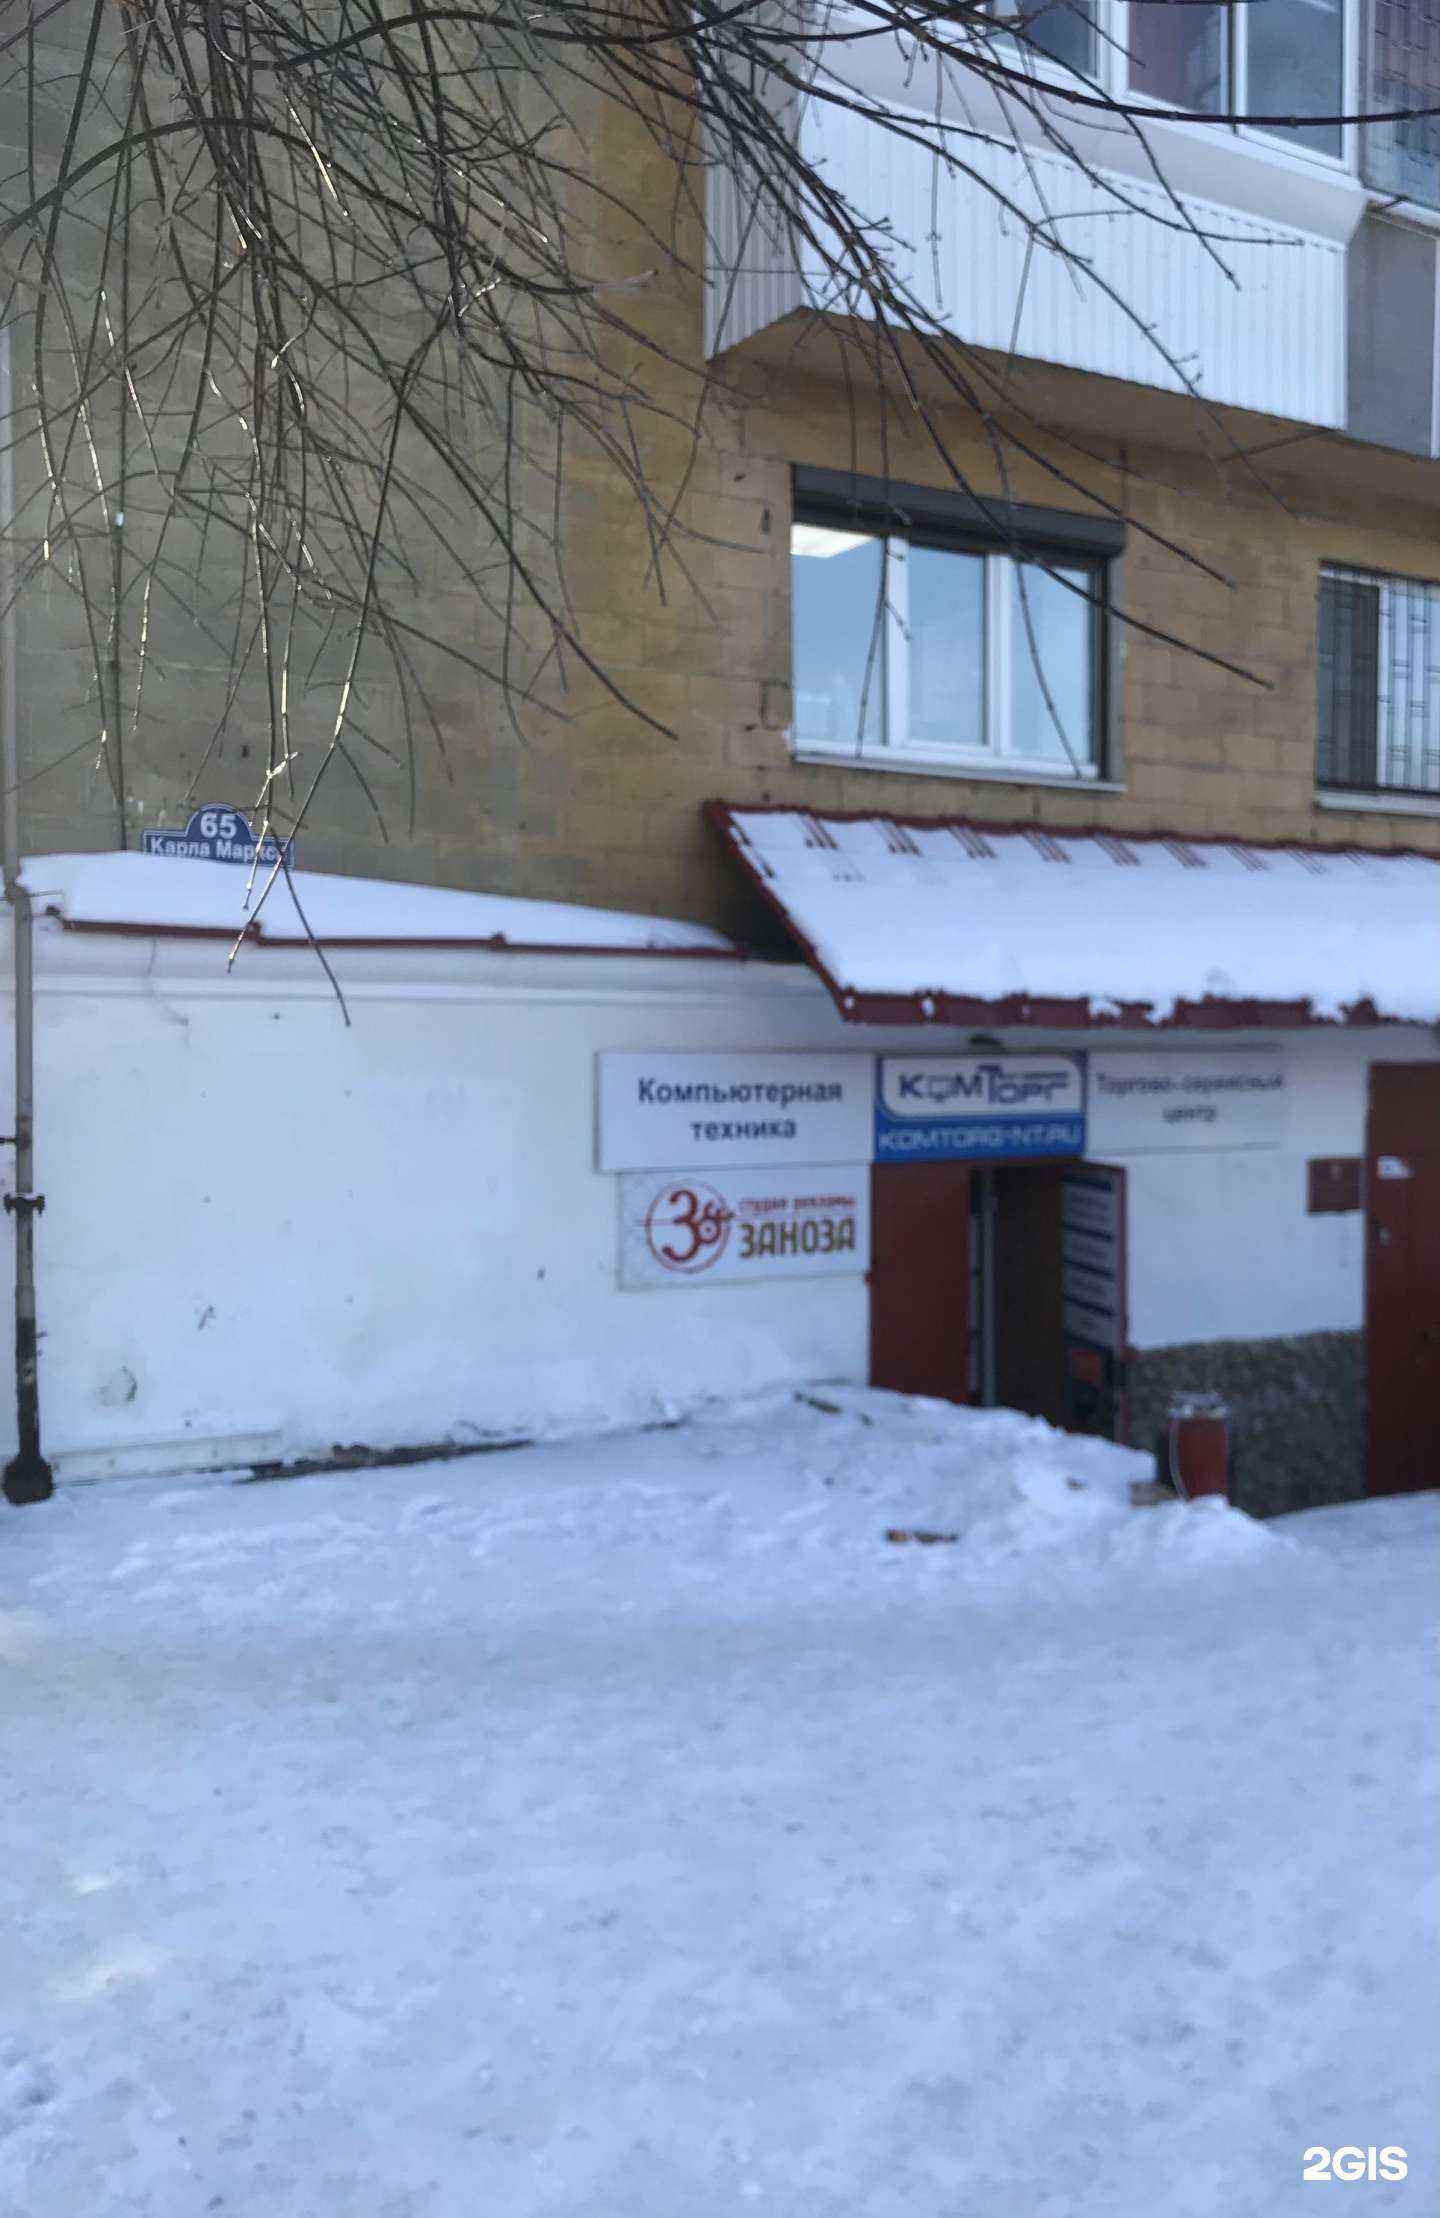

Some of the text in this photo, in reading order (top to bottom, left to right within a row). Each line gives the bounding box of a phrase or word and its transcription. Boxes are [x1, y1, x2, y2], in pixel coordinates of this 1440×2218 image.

[200, 812, 237, 839] 65
[151, 837, 210, 858] Карла
[638, 1077, 843, 1109] Компьютерная
[690, 1118, 797, 1142] техника
[738, 1217, 856, 1259] ЗАНОЗА
